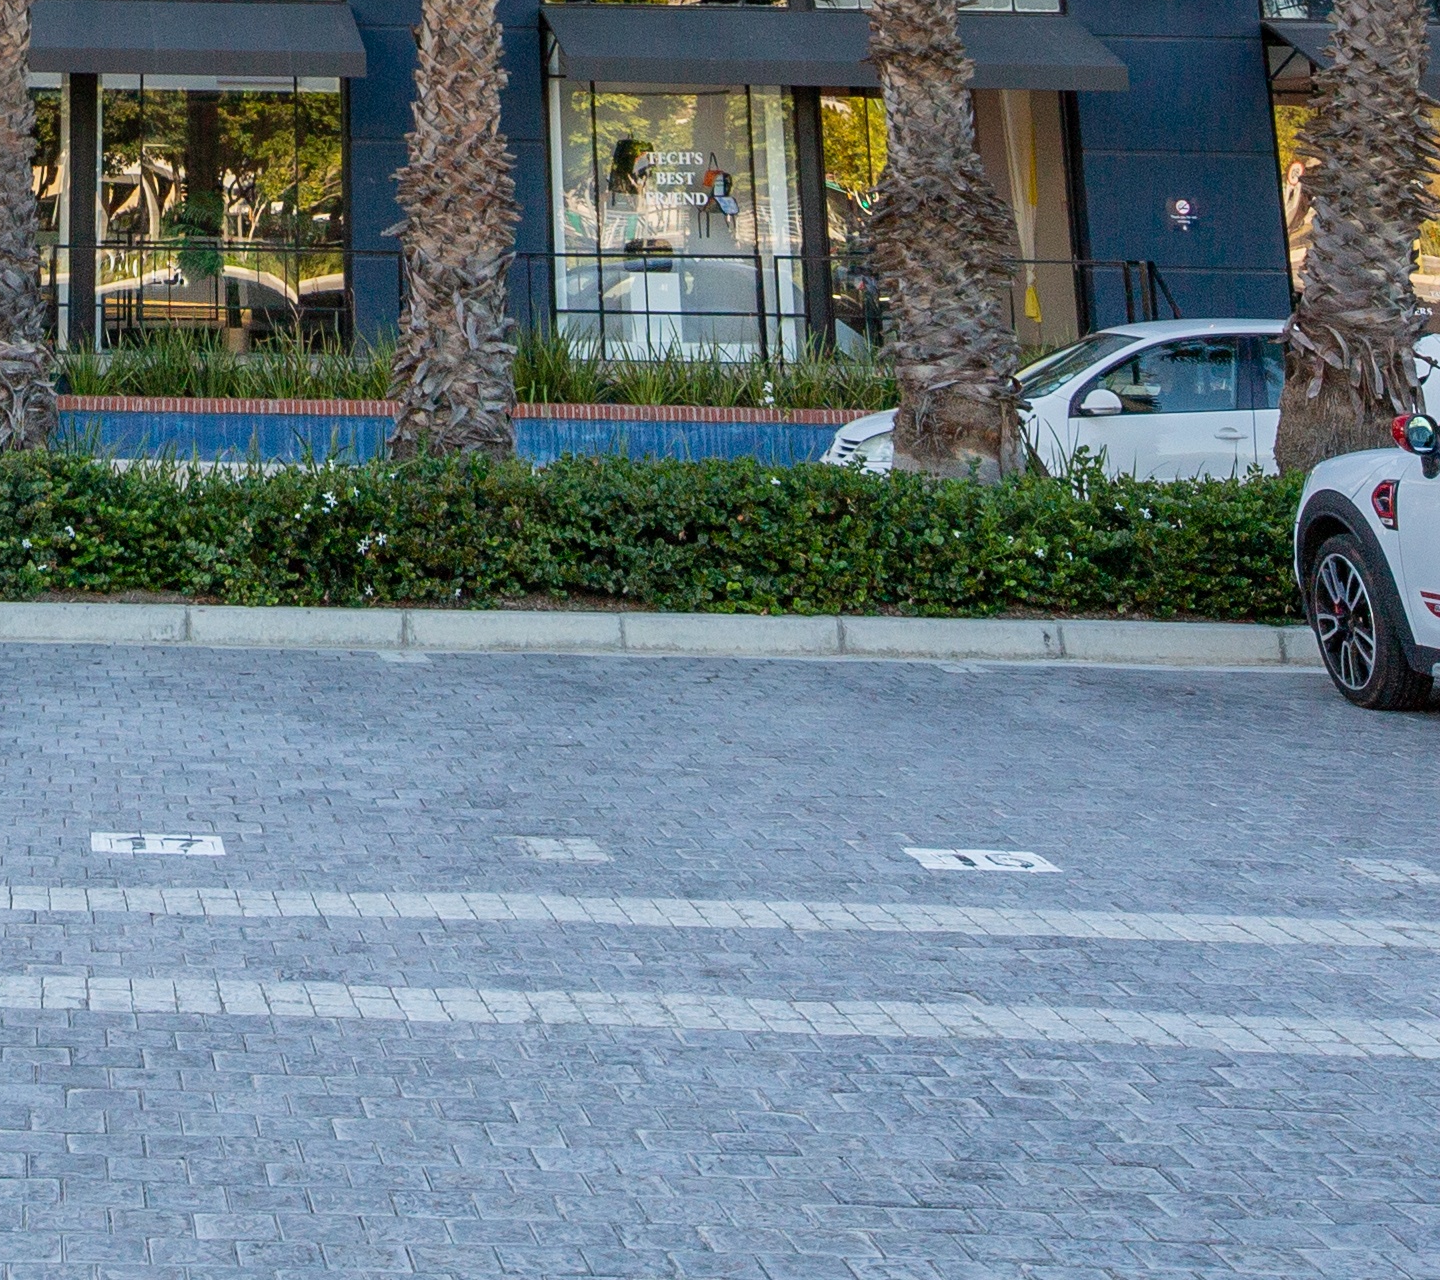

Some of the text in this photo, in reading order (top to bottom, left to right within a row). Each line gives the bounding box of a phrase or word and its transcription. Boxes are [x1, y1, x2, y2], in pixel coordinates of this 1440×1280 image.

[647, 151, 704, 166] TECH'S
[656, 171, 696, 186] BEST
[645, 191, 710, 207] FRIEND
[116, 836, 204, 852] 17
